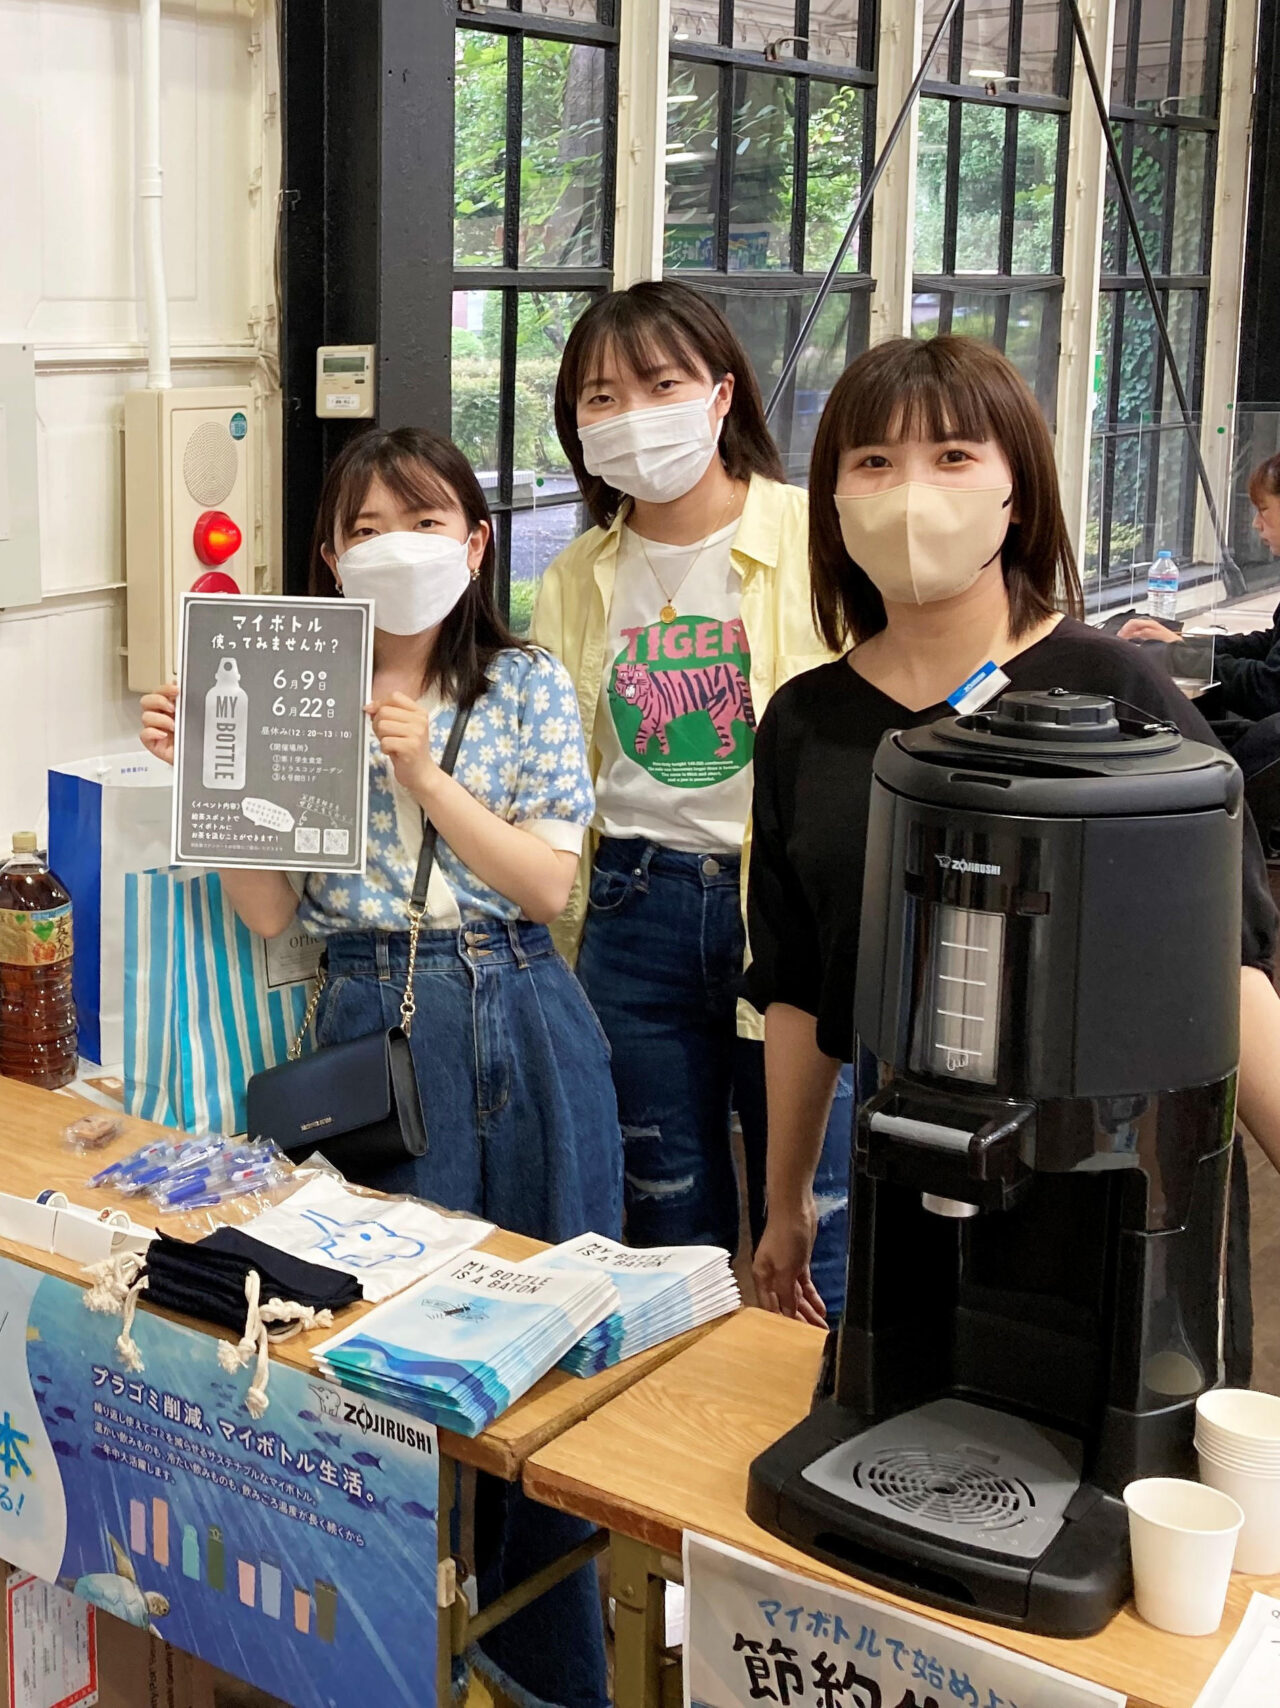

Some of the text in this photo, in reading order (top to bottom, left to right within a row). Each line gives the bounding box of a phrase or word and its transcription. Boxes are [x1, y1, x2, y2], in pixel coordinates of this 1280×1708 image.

[232, 614, 322, 633] マイボトル
[620, 618, 751, 662] TIGER
[216, 695, 238, 719] MY
[214, 722, 236, 780] BOTTLE
[450, 1269, 542, 1294] IS A BATON
[462, 1261, 552, 1286] MY BOTTLE
[93, 1367, 374, 1503] プラゴミ削減、マイボトル生活。
[343, 1401, 433, 1455] ZOJIRUSHI
[733, 1633, 940, 1708] 節約
